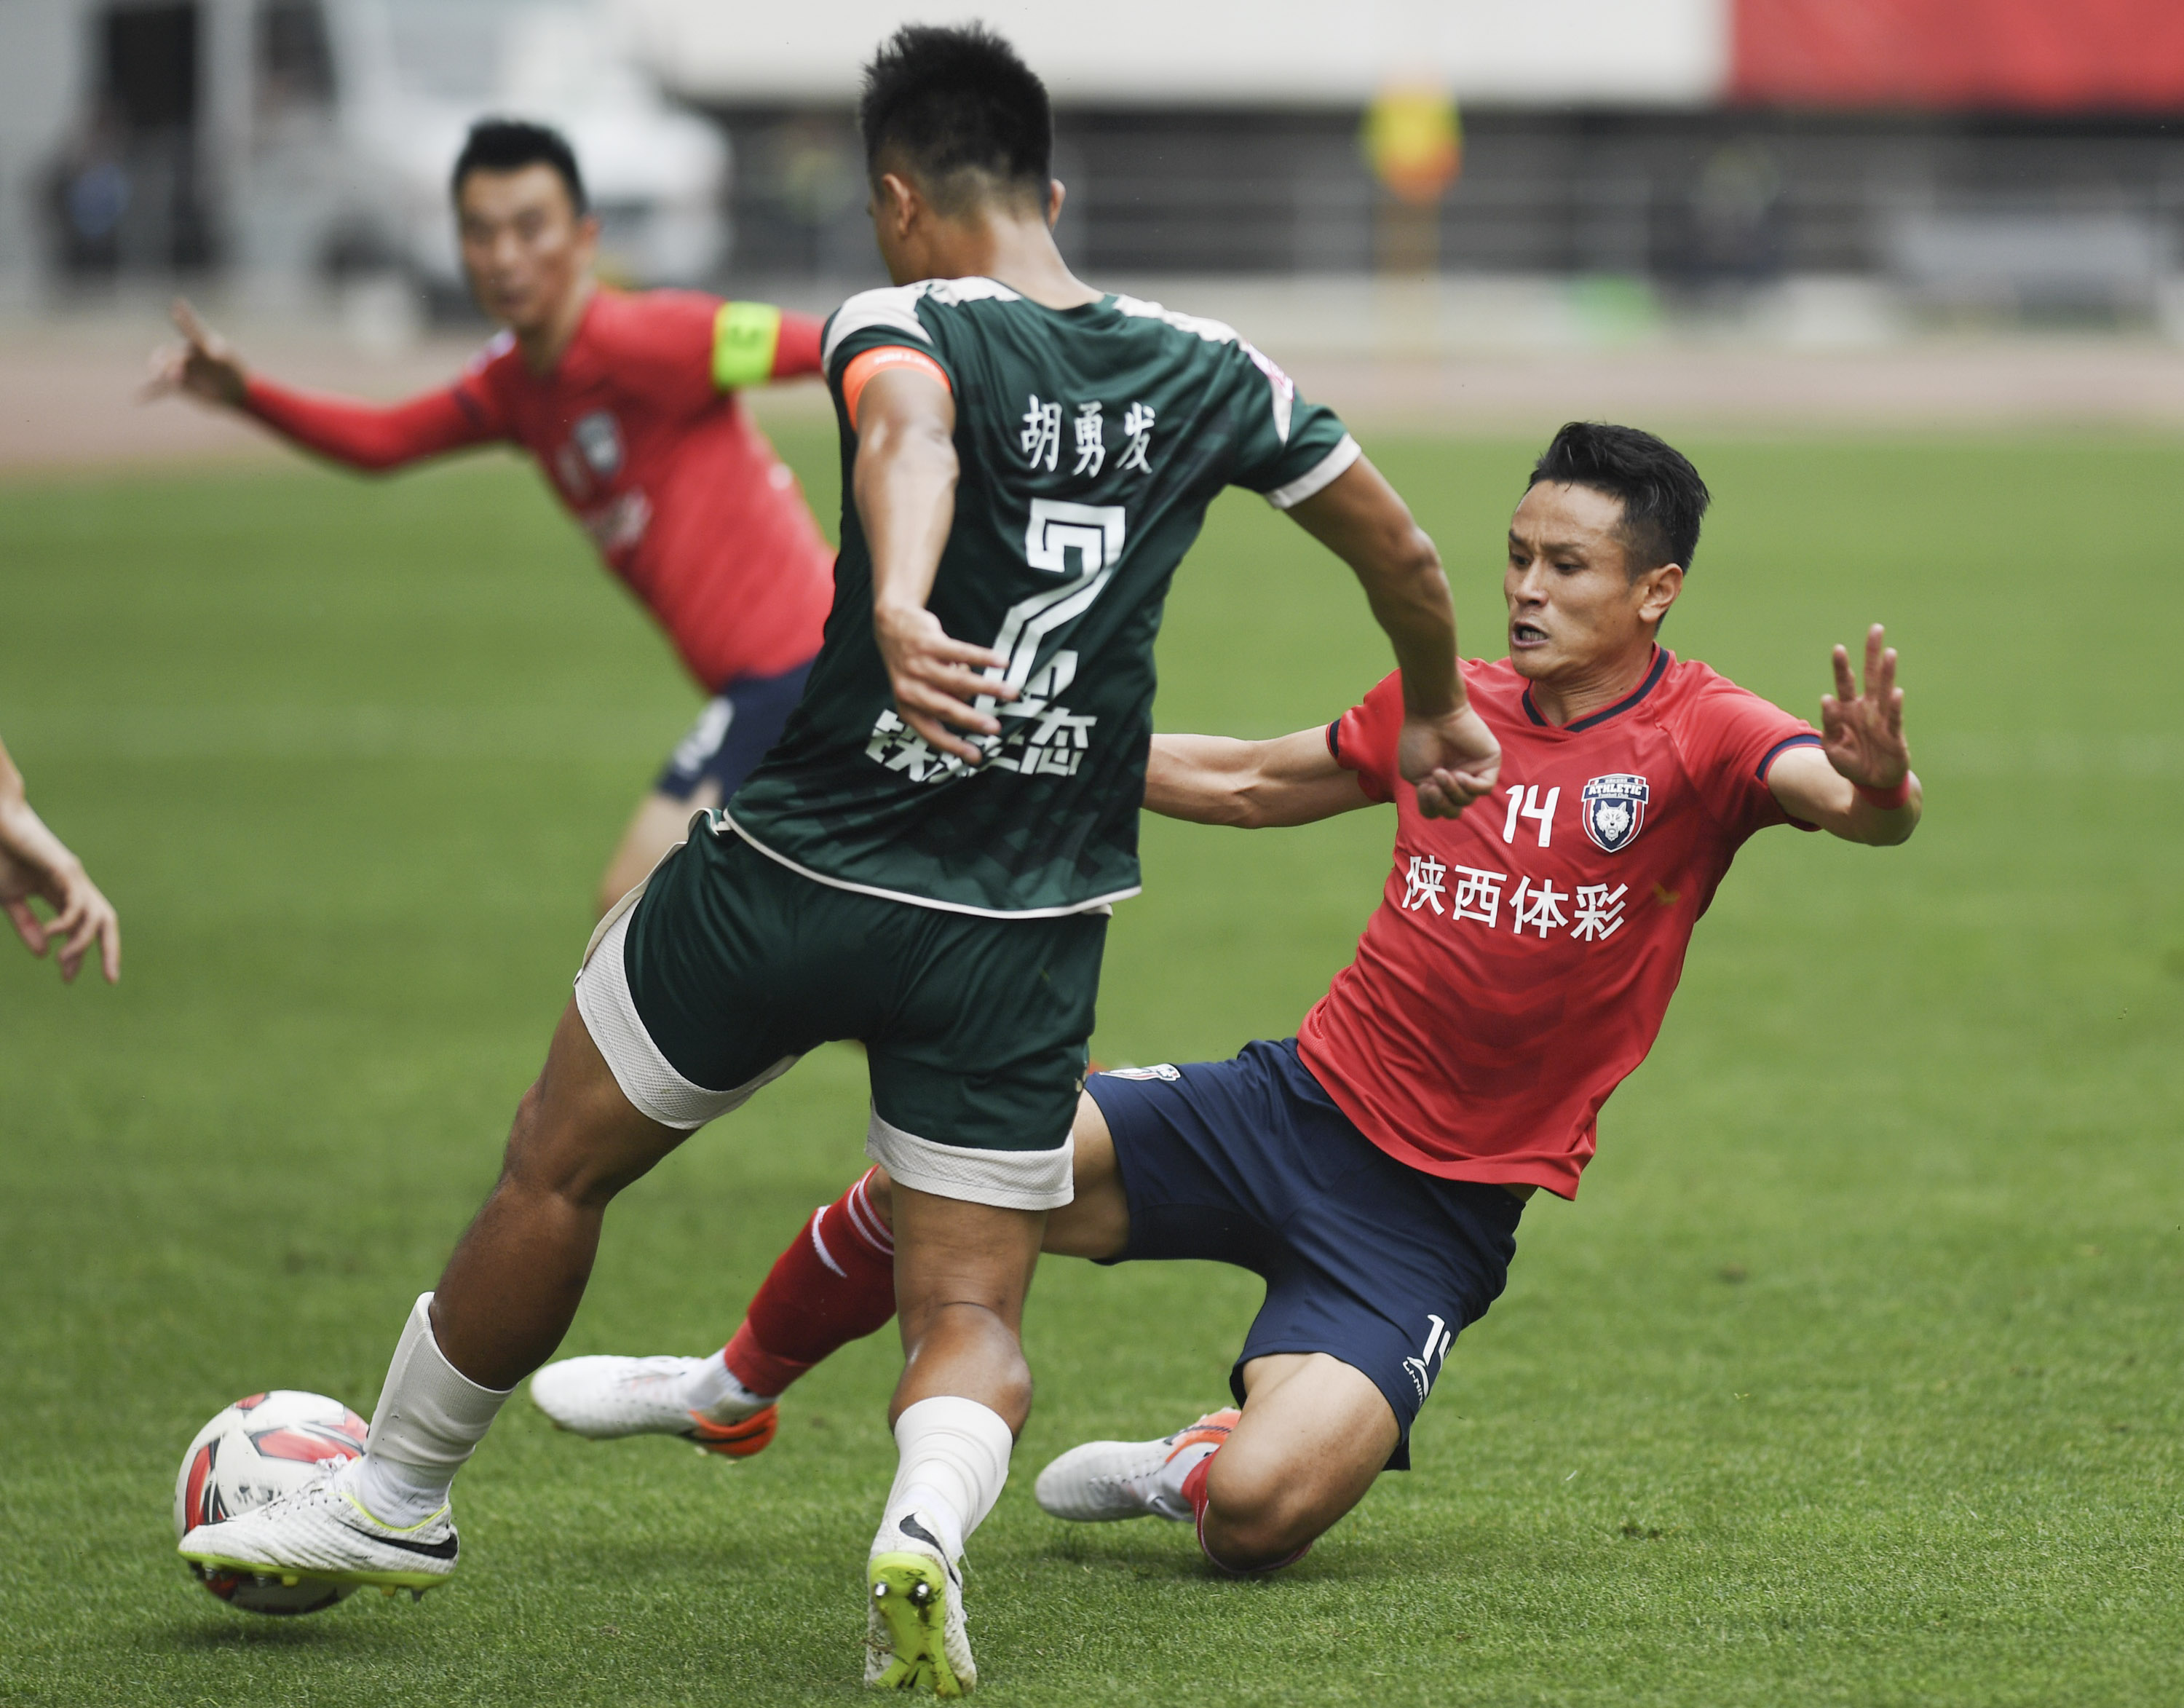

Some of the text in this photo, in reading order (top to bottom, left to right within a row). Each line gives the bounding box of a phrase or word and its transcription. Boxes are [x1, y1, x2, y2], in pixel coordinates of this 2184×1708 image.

[1020, 393, 1156, 478] 胡勇发
[1503, 784, 1561, 848] 14
[1588, 783, 1642, 796] ATHLETIC
[1401, 854, 1629, 942] 陕西体彩
[1402, 1360, 1423, 1409] LI-NIN
